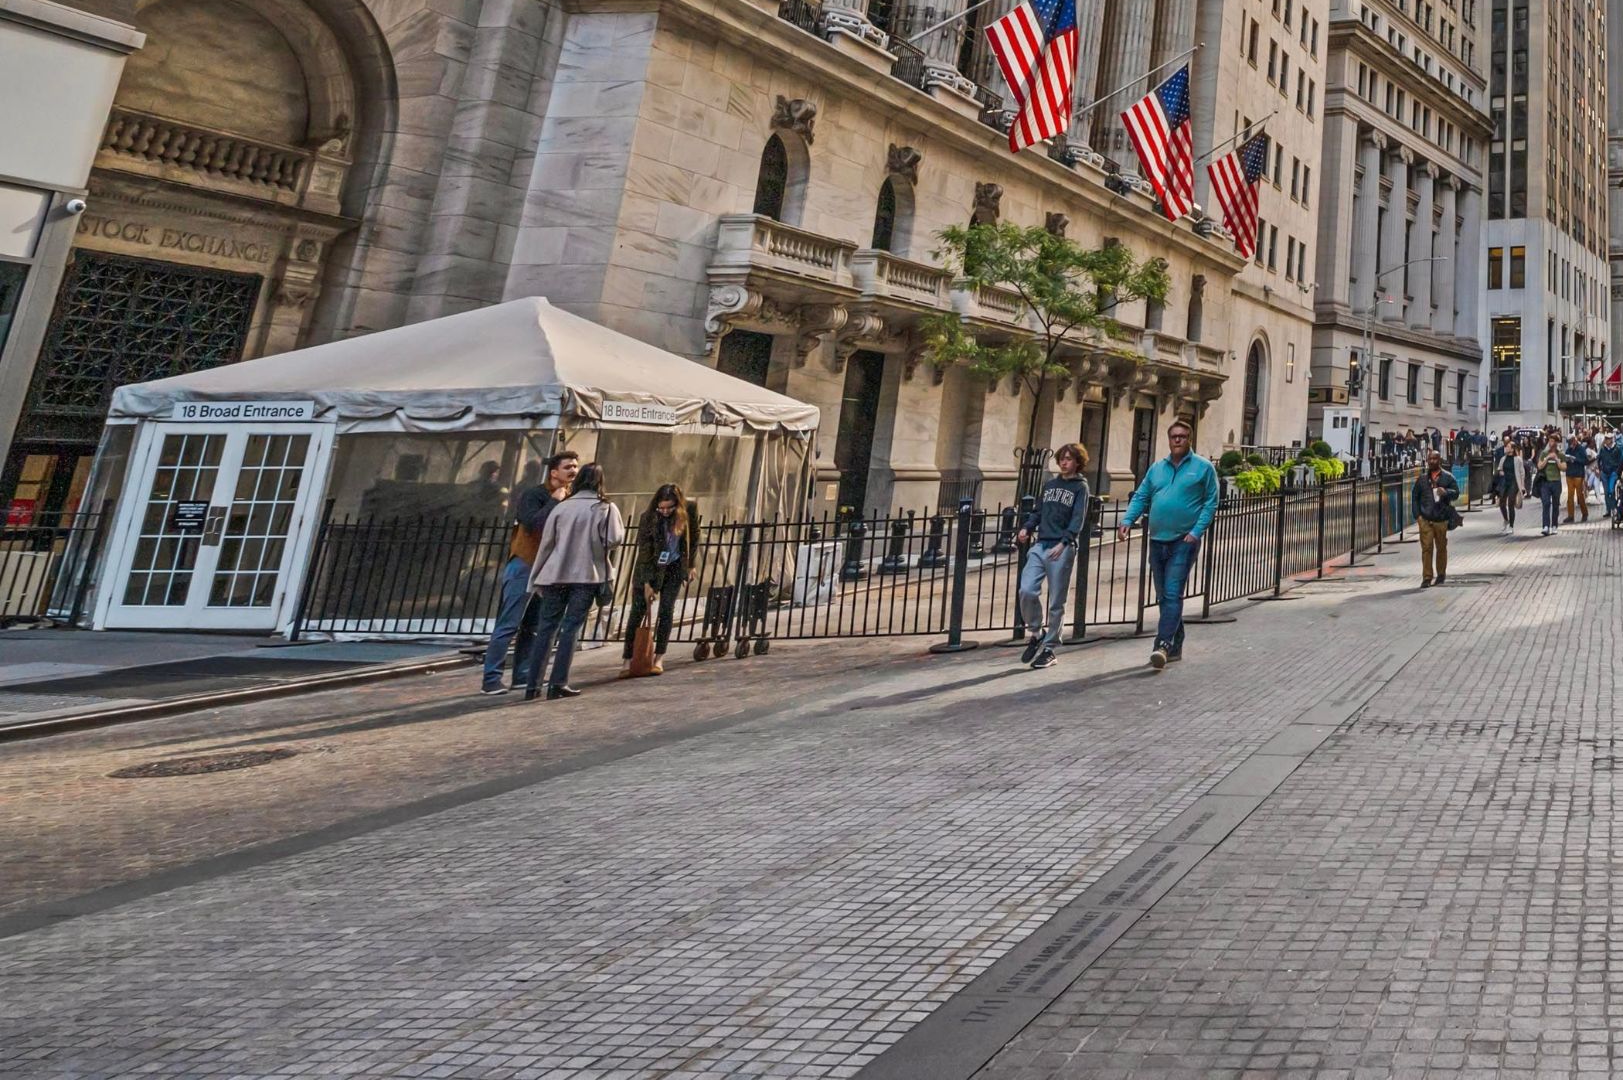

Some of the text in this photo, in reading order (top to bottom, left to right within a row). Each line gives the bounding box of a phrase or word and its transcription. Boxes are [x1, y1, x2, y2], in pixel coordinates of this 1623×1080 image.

[77, 216, 270, 263] STOCK EXCHANGE
[182, 405, 304, 417] 18 Broad Entrance
[604, 405, 675, 421] 18 Broad Entrance
